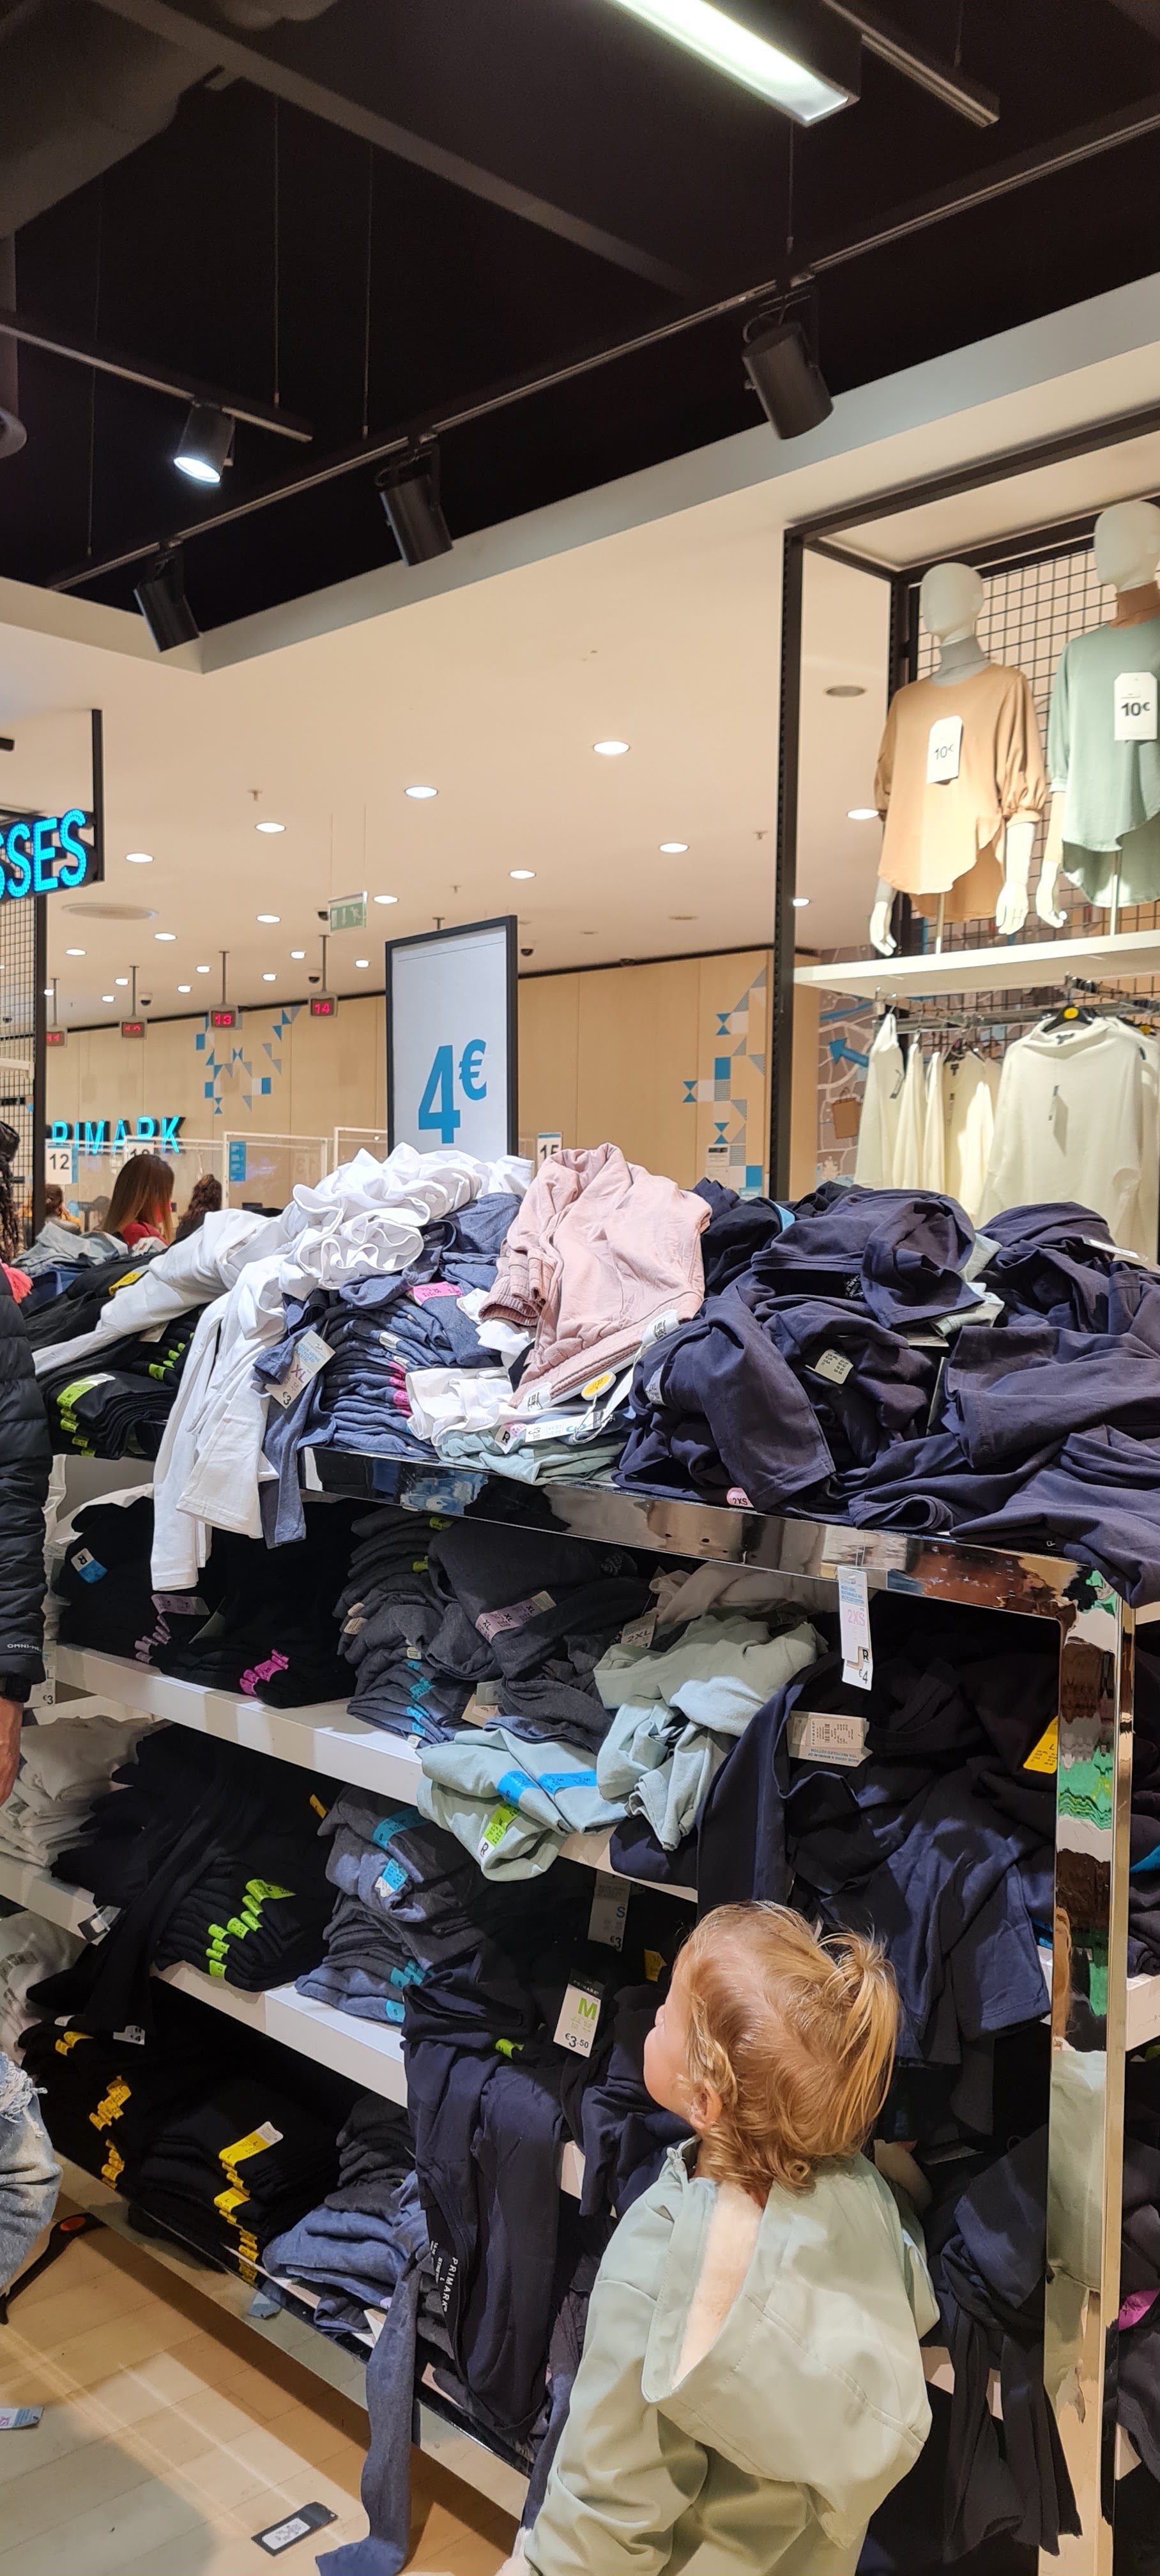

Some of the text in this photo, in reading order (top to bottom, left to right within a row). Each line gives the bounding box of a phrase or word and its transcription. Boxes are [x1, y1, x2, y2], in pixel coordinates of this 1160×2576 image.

[1120, 702, 1150, 716] 10€
[934, 744, 954, 760] 10€
[0, 809, 87, 899] SES
[315, 1002, 330, 1015] 14
[215, 1015, 232, 1025] 13
[418, 1039, 487, 1144] 4€
[47, 1116, 180, 1154] RIMARK
[49, 1153, 70, 1170] 12
[291, 1364, 306, 1384] XL
[282, 1392, 292, 1406] €3
[504, 1613, 513, 1623] XL
[848, 1609, 866, 1627] 2XS
[483, 1620, 491, 1631] XL
[627, 1630, 652, 1643] 2XL
[862, 1649, 869, 1661] R
[859, 1669, 868, 1684] €4
[43, 1695, 54, 1705] €3
[480, 1842, 489, 1856] R
[616, 1906, 626, 1918] S
[577, 1997, 598, 2020] M
[565, 2032, 590, 2048] €3.50
